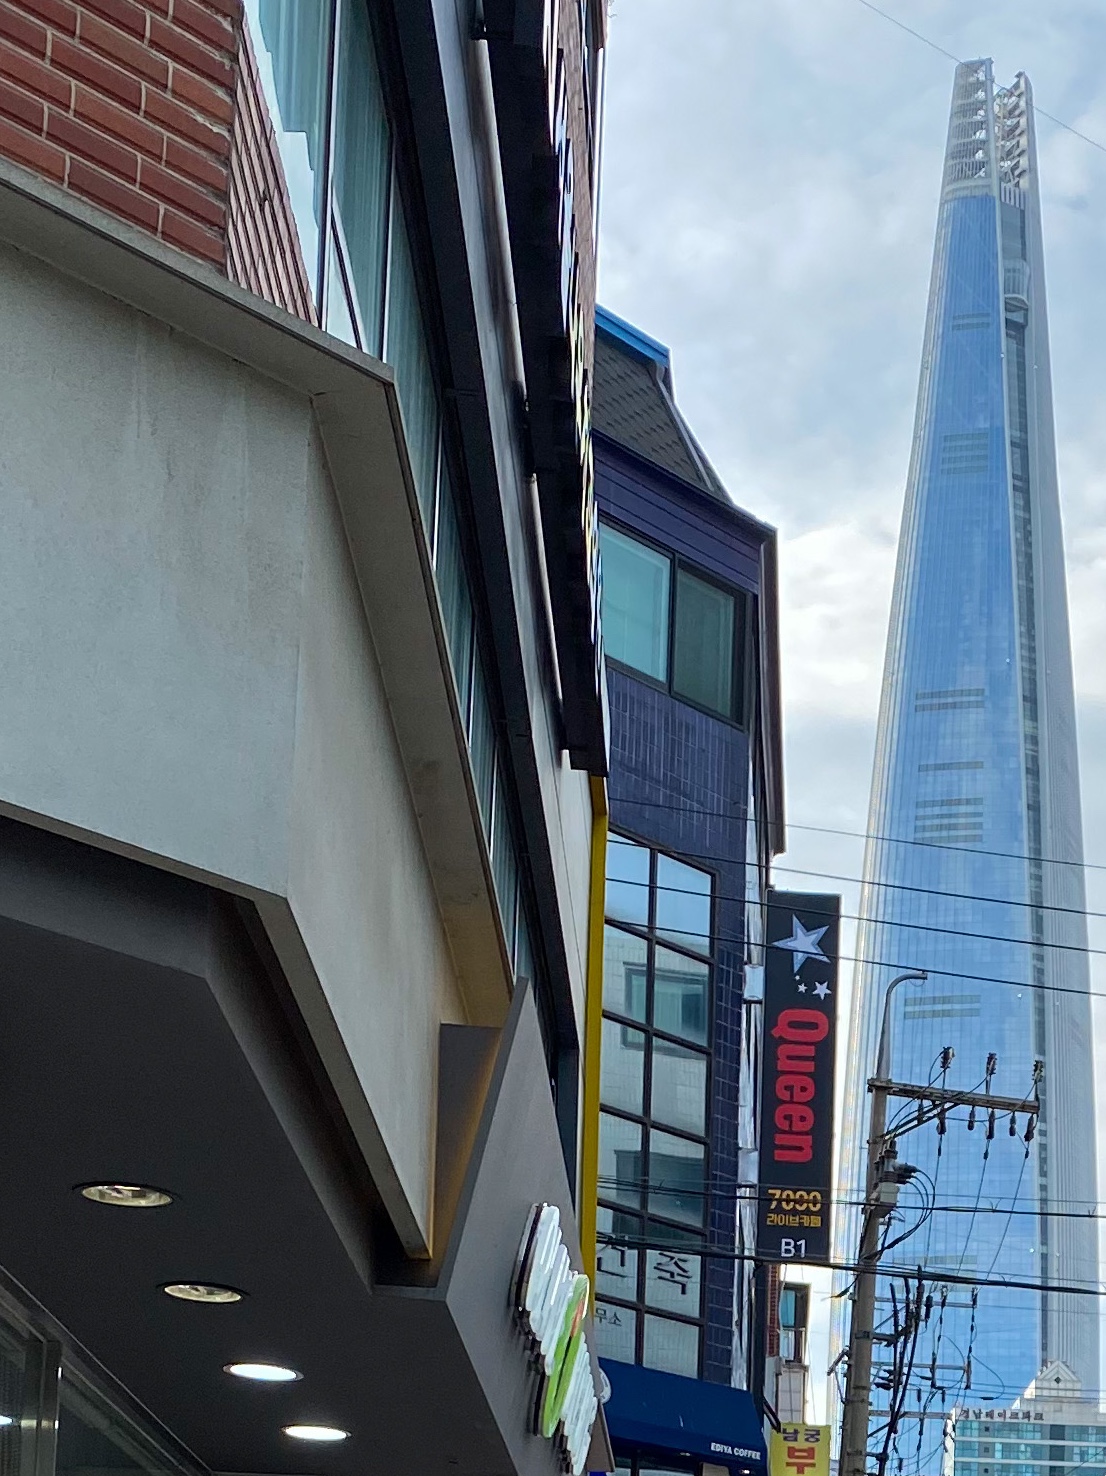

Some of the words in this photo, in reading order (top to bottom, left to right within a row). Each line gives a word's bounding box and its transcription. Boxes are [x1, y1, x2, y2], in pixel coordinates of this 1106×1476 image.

[772, 1008, 829, 1163] Queen
[768, 1189, 821, 1211] 7000
[781, 1238, 806, 1258] B1
[782, 1428, 820, 1443] 남궁
[711, 1442, 732, 1455] EDIYA
[733, 1447, 761, 1460] COFFEE
